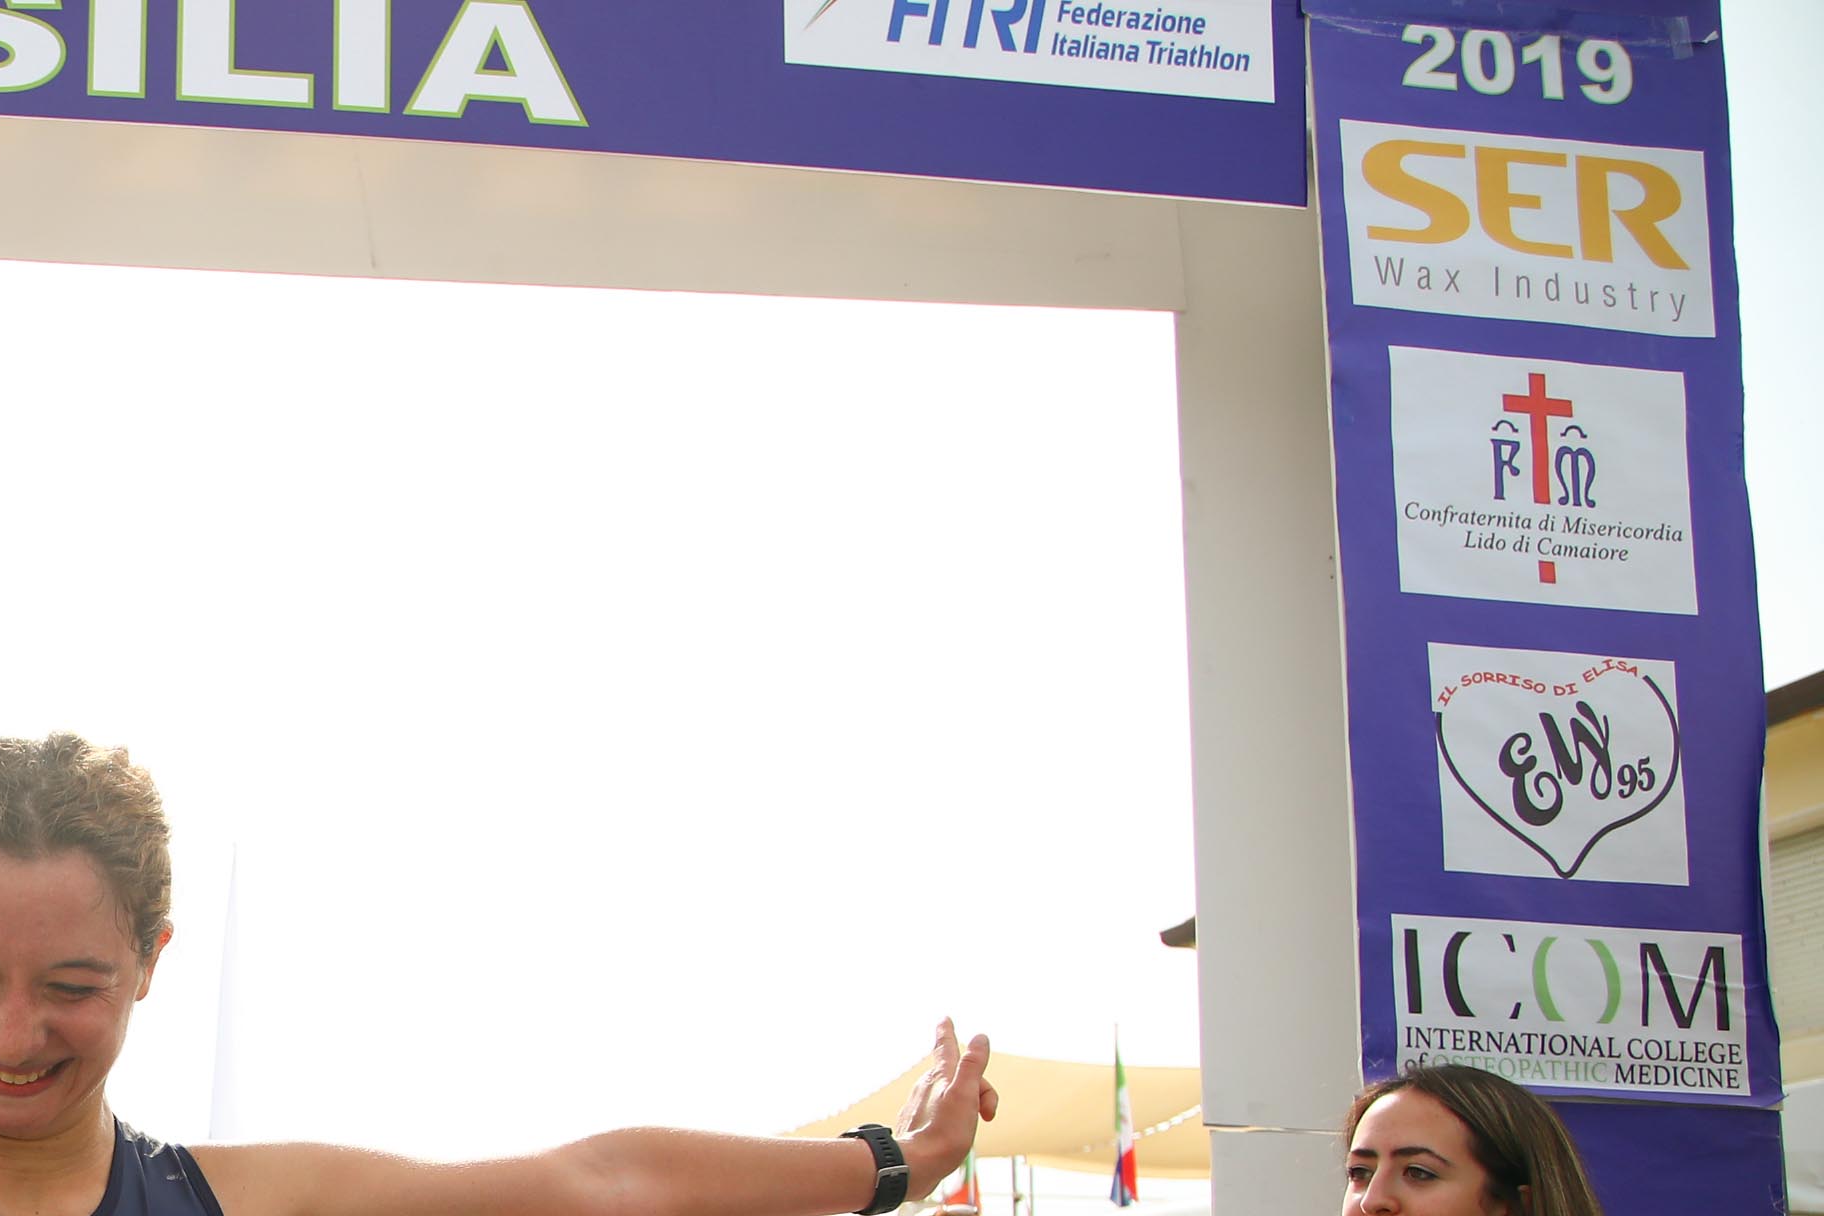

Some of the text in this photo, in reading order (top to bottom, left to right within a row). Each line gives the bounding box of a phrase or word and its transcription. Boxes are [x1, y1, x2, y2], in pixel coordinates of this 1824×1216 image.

[1056, 0, 1207, 35] Federazione
[1050, 32, 1251, 72] Italiana Triathlon
[1401, 24, 1634, 105] 2019
[1361, 139, 1691, 270] SER
[1374, 255, 1687, 322] Wax Industry
[1403, 501, 1684, 543] Confraternita di Misericordia
[1463, 530, 1629, 562] Lido di Camaiore
[1437, 658, 1639, 706] IL SORRISO DI ELISA
[1616, 755, 1656, 799] 95
[1404, 928, 1731, 1031] ICOM
[1404, 1026, 1743, 1066] INTERNATIONAL COLLEGE
[1613, 1062, 1741, 1090] MEDICINE
